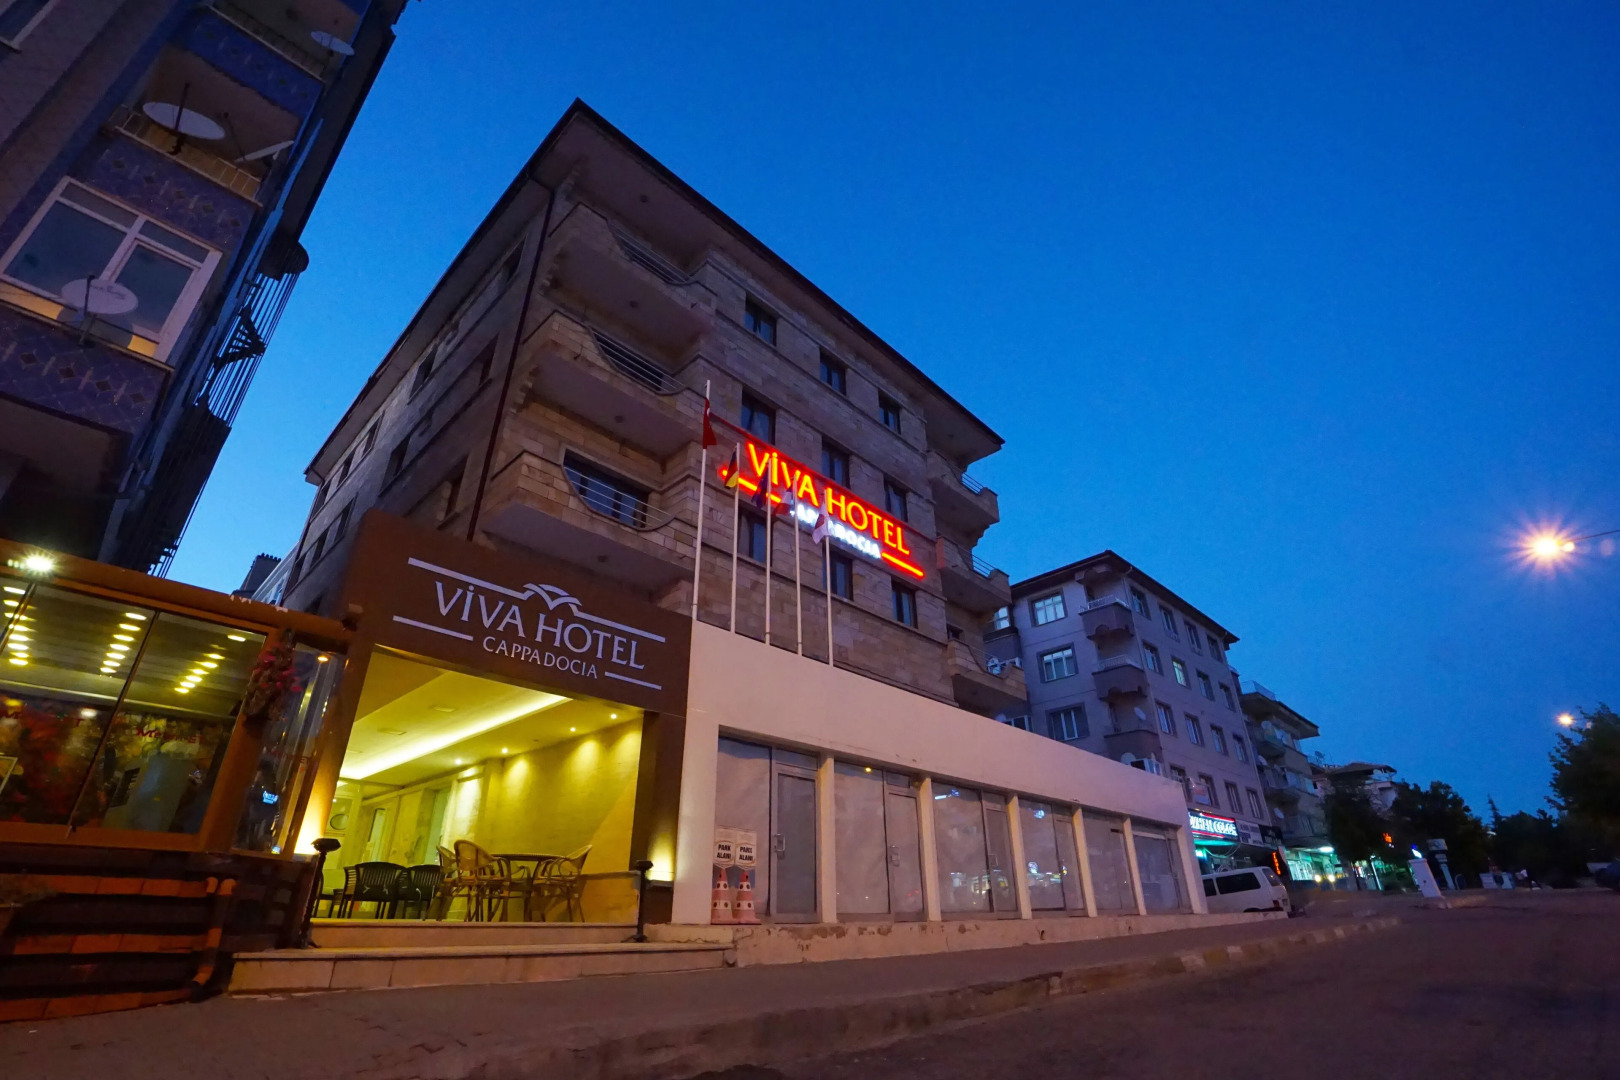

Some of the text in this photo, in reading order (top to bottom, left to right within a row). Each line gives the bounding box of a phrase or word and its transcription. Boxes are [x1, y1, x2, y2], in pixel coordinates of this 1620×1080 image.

[826, 487, 910, 555] HOTEL
[482, 635, 598, 679] CAPPADOCIA
[535, 612, 645, 670] HOTEL
